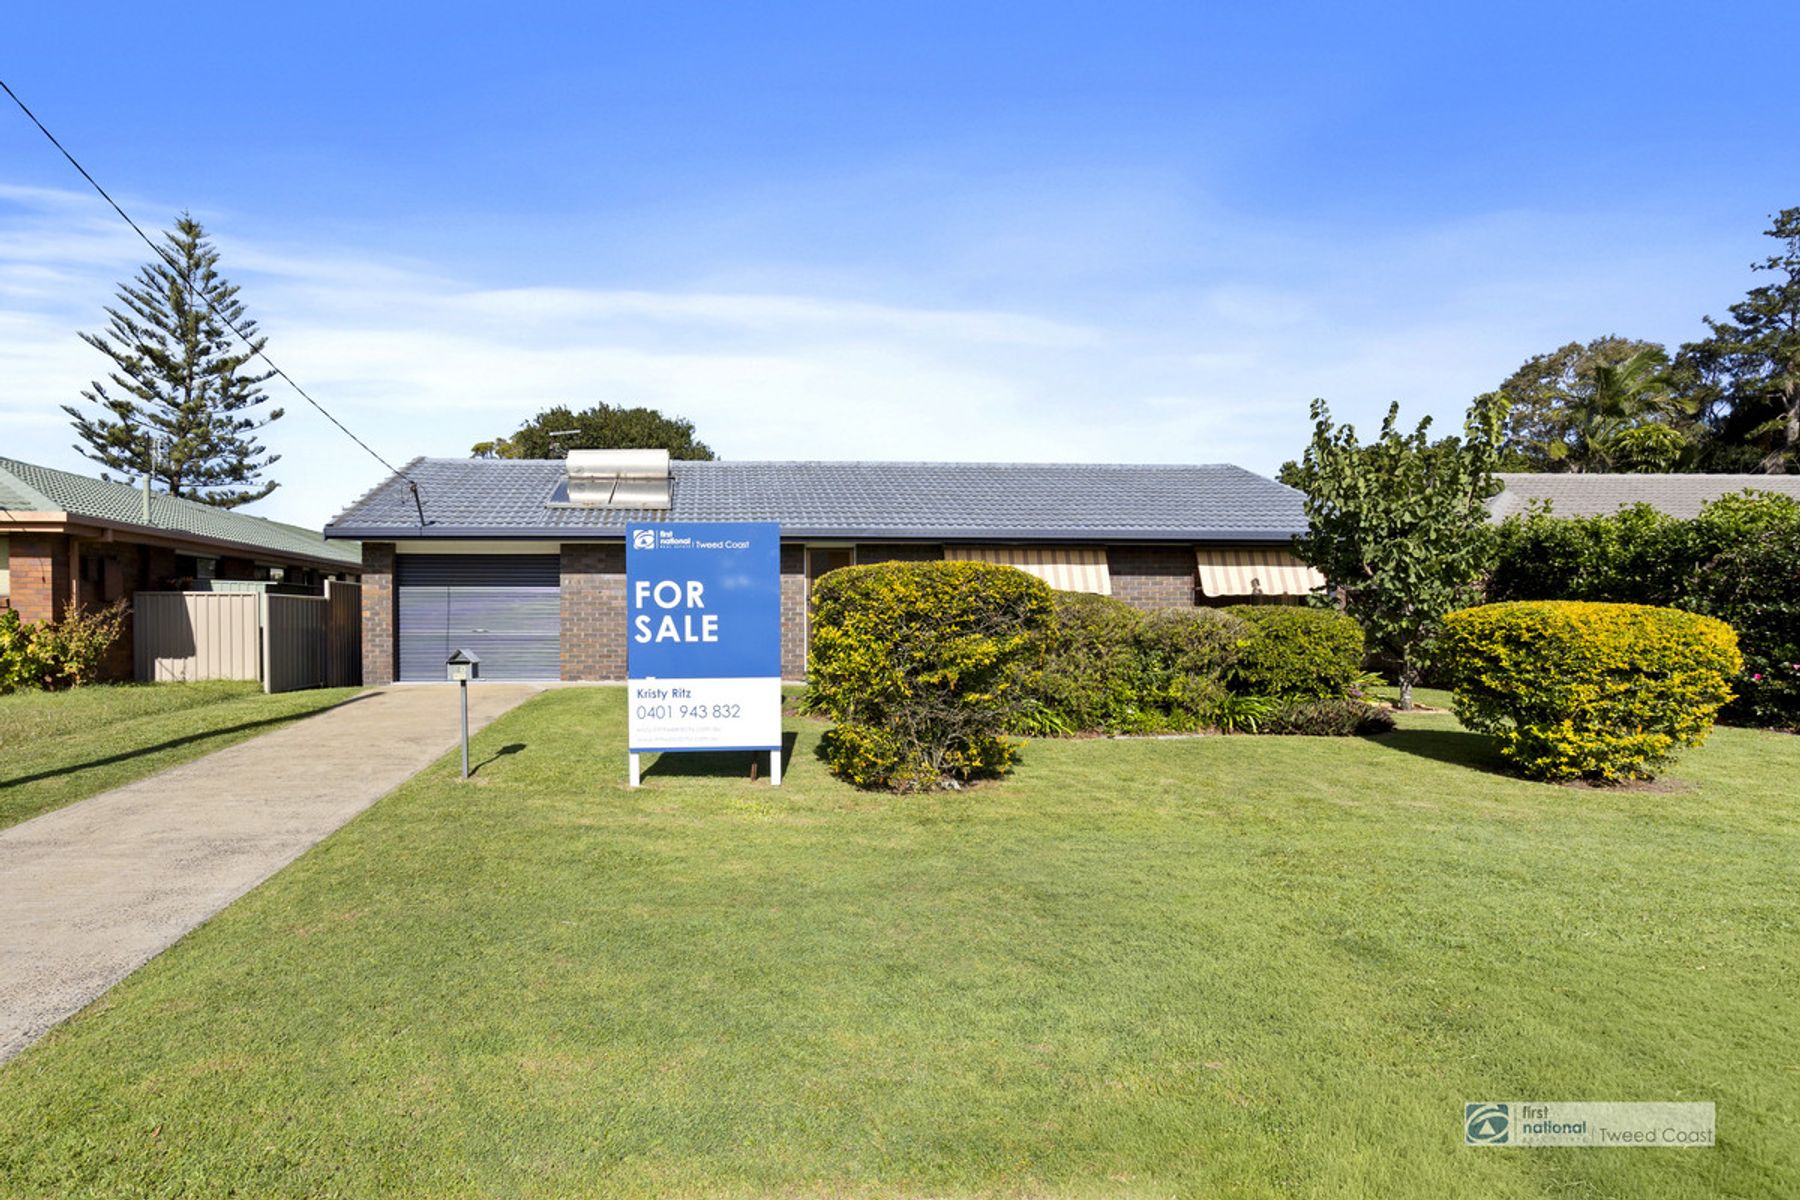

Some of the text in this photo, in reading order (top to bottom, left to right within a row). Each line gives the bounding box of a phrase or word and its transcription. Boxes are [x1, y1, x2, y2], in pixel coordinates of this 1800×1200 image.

[696, 540, 723, 549] Tweed
[724, 540, 750, 549] Coast
[635, 580, 704, 609] FOR
[634, 614, 719, 644] SALE
[636, 688, 692, 701] Kristy Ritz
[636, 704, 741, 719] 0401 943 832
